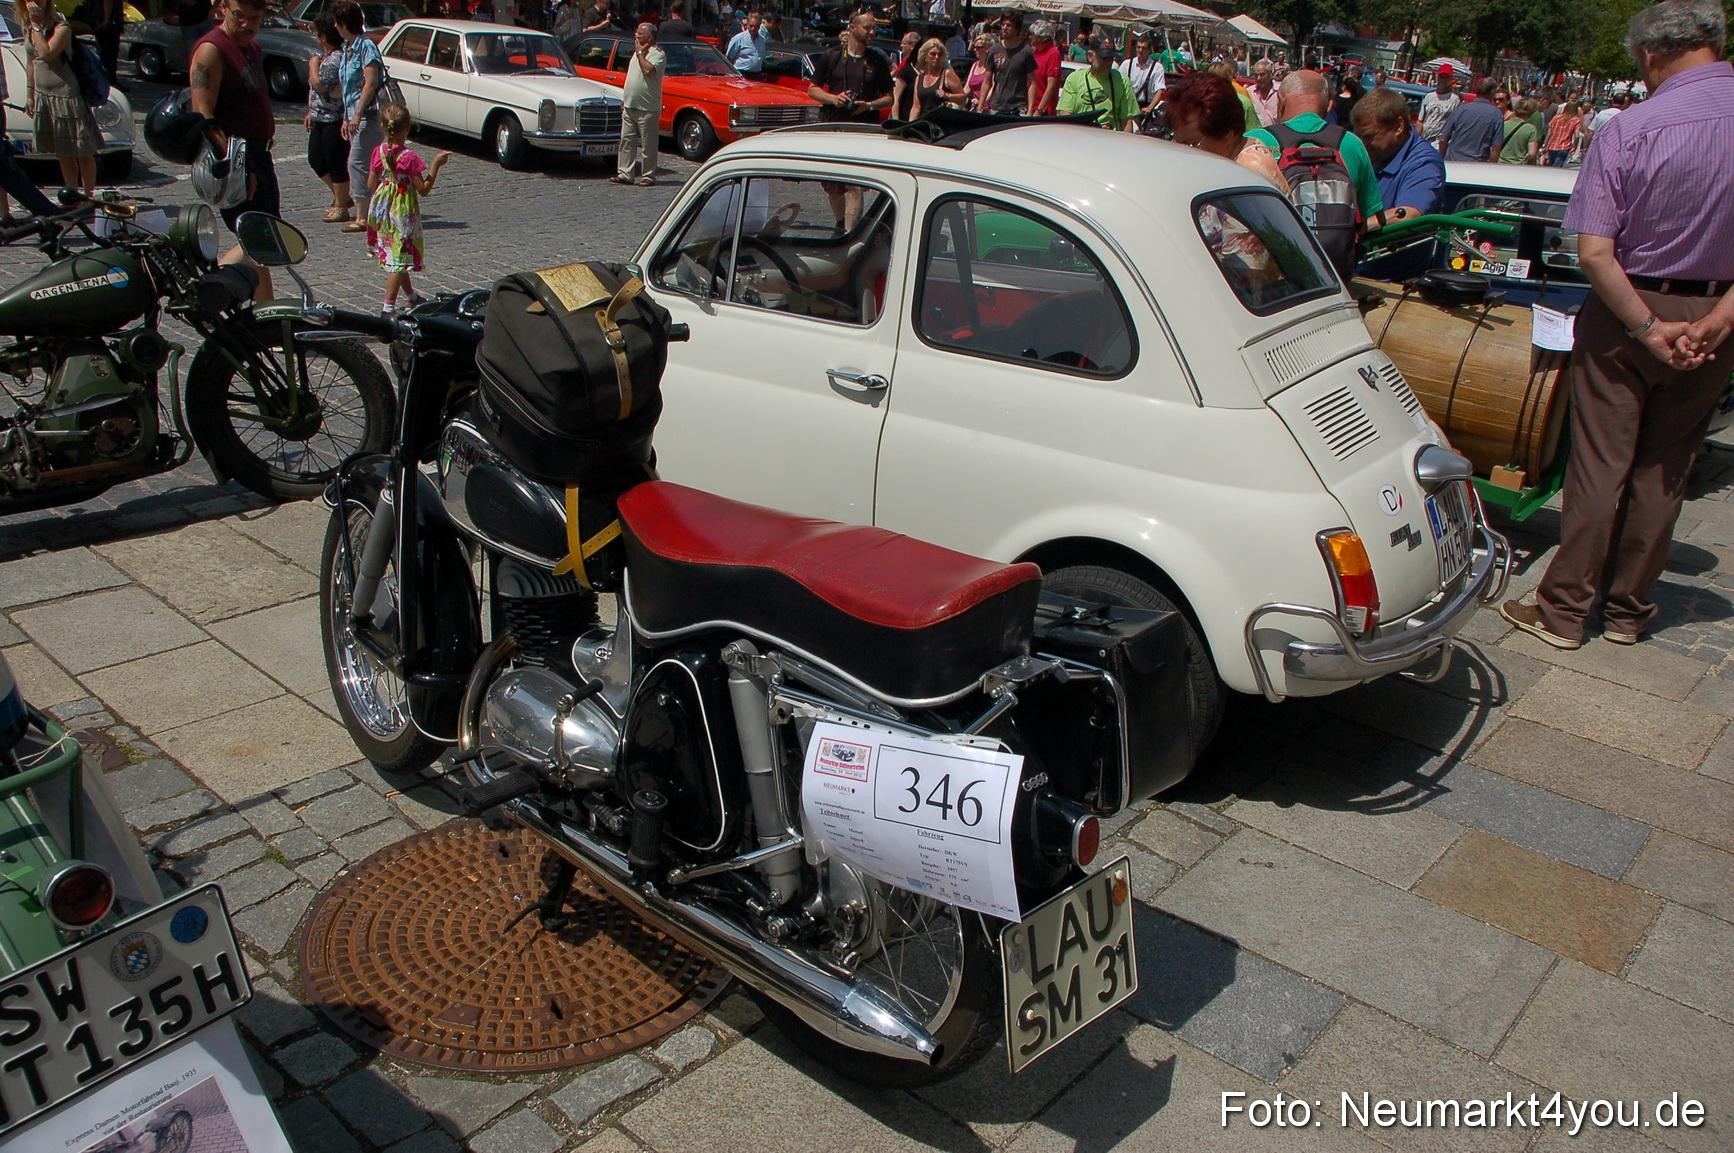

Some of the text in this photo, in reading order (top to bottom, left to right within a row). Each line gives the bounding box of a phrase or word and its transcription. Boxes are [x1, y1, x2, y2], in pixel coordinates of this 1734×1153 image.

[1036, 1, 1063, 10] Tucher
[34, 276, 108, 300] ARGENTINA
[1482, 263, 1505, 273] Agip
[1382, 489, 1398, 512] D
[823, 782, 850, 793] NEUMARKT
[898, 767, 986, 826] 346
[917, 828, 944, 841] Fahrzeug
[1027, 877, 1114, 986] LAU
[0, 957, 87, 1047] SW
[1017, 931, 1131, 1056] SM 31
[65, 952, 240, 1085] 135H
[65, 1067, 198, 1148] Express Damen Motorfahrrad Bauj. 1935
[102, 1093, 174, 1136] vor der Restaurierung
